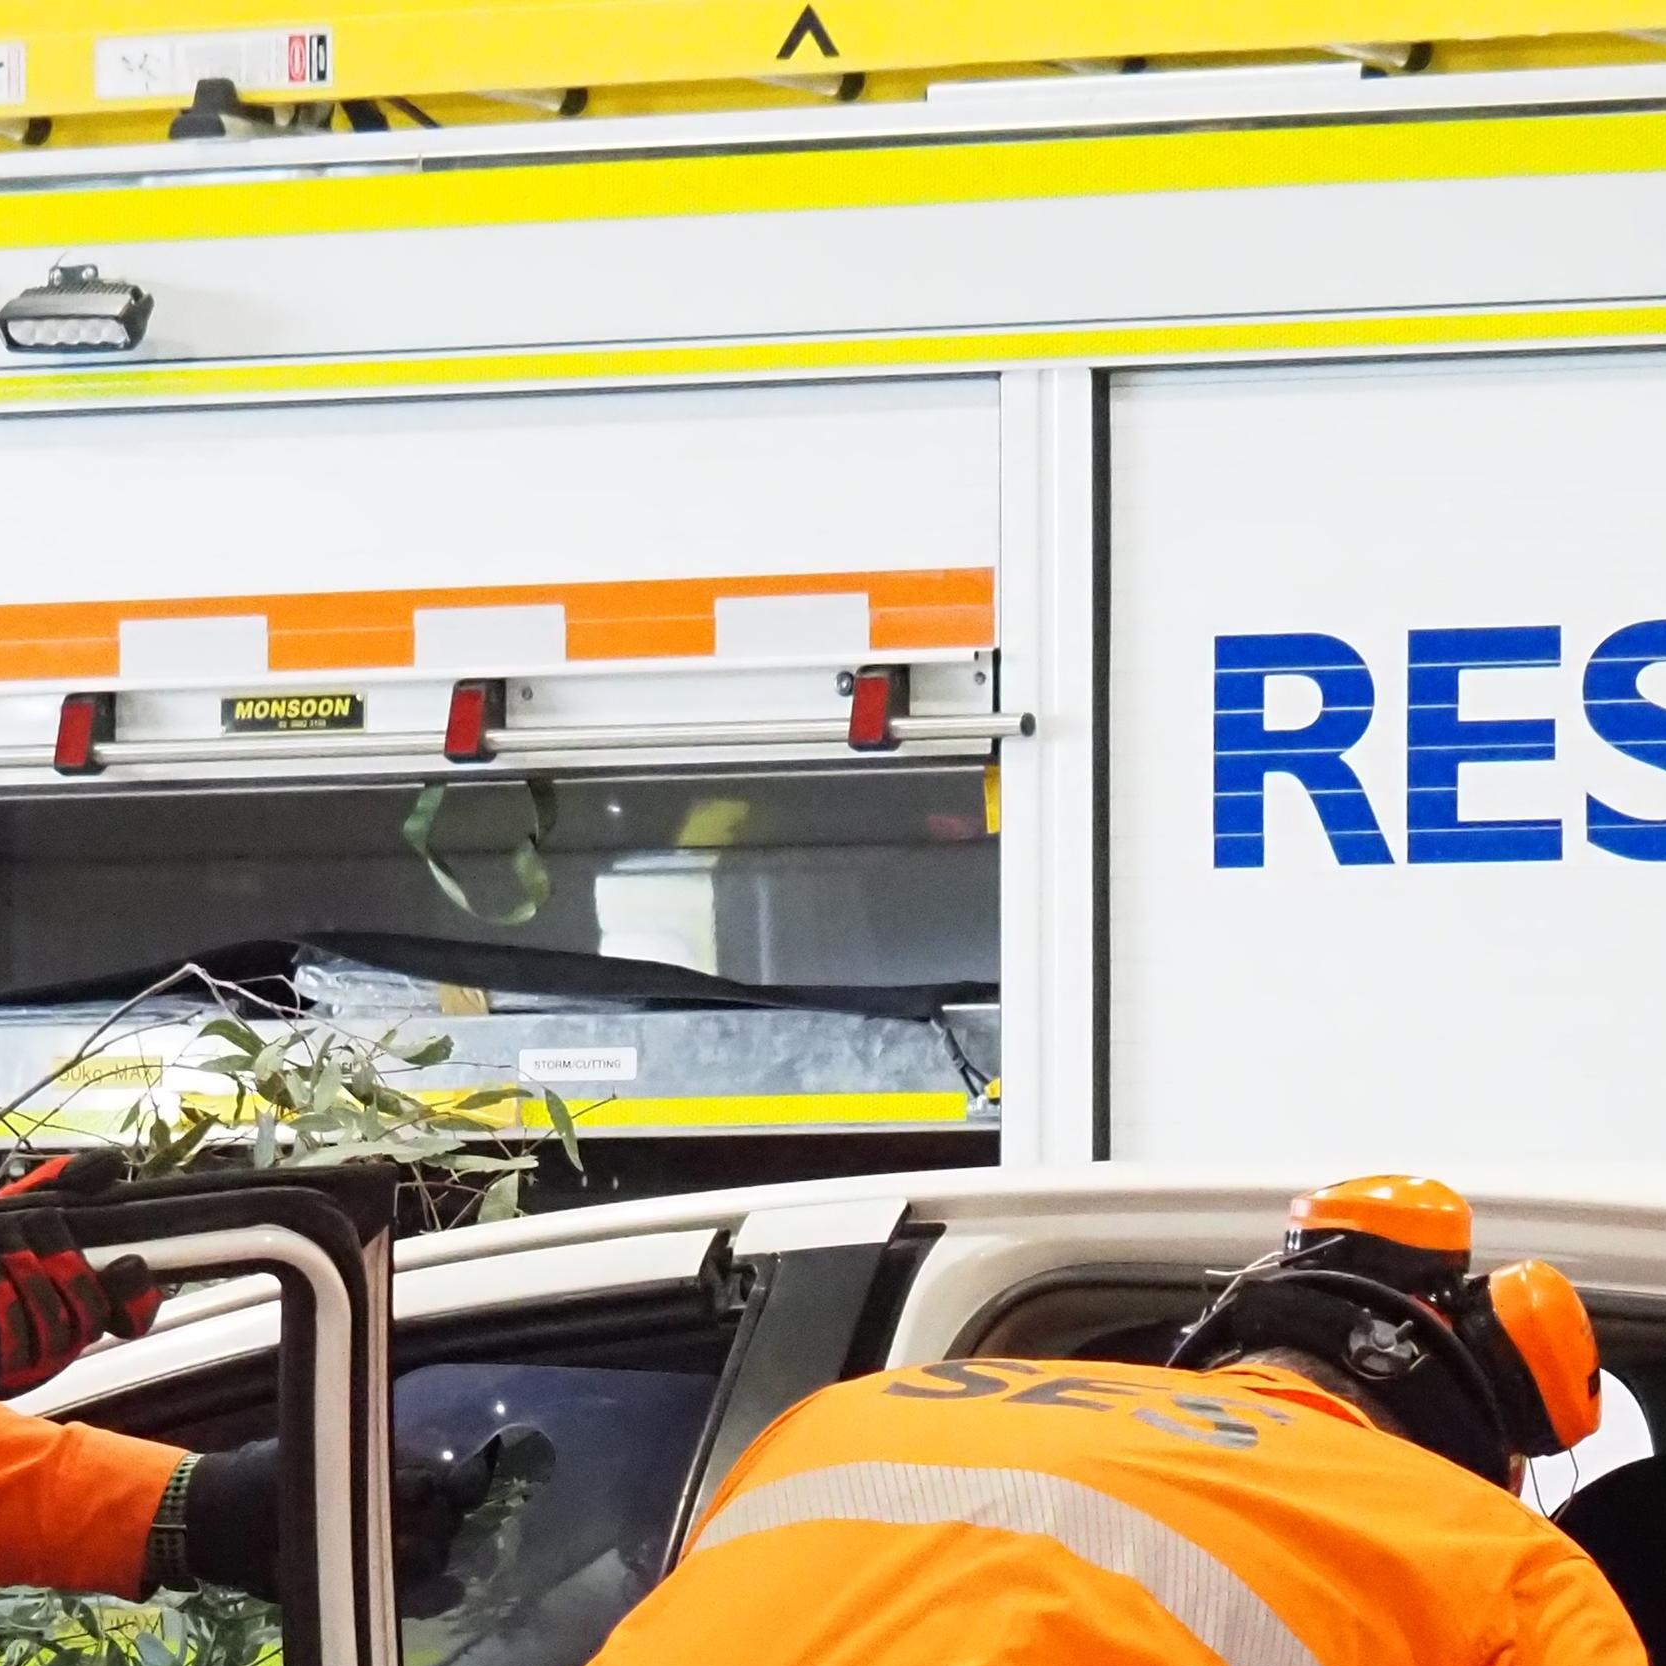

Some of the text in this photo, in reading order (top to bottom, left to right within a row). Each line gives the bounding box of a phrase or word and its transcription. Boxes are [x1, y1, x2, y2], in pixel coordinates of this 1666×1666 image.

[234, 697, 351, 719] MONSOON
[533, 1058, 622, 1071] STORM/CUTTING
[881, 1357, 1296, 1450] SES
